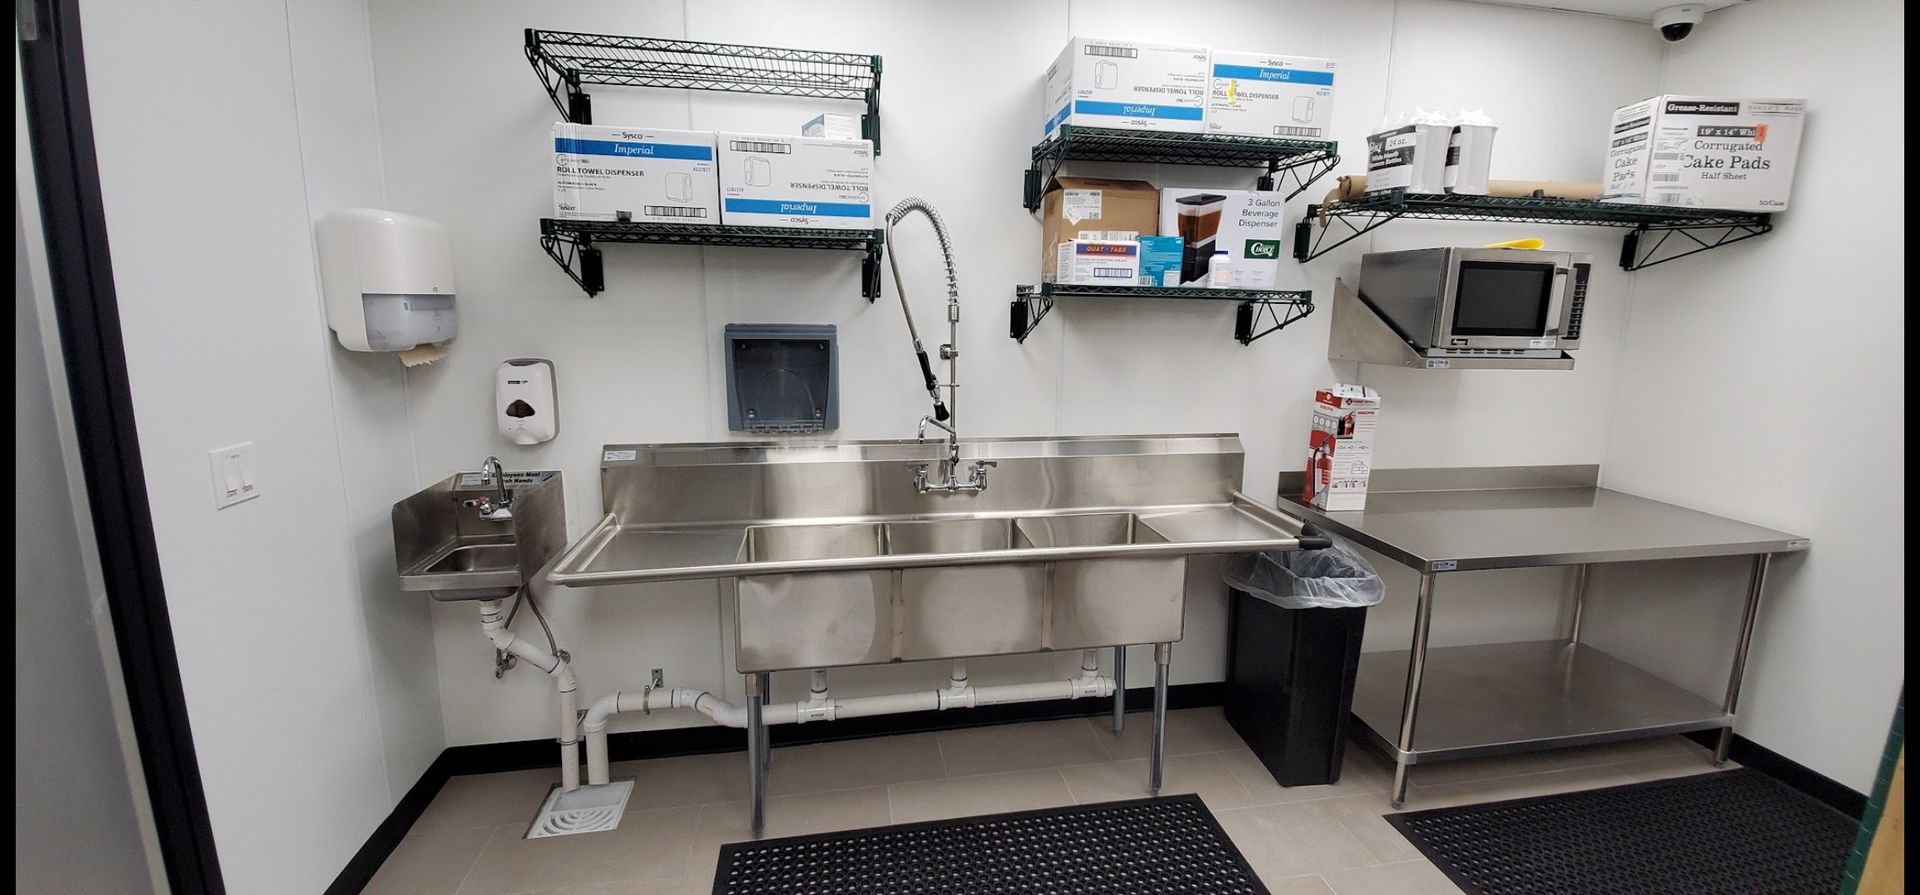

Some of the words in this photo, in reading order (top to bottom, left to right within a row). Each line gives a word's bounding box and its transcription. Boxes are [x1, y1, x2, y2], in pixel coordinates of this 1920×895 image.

[1268, 59, 1284, 67] Sysco
[1259, 69, 1290, 80] Imperial
[1122, 106, 1156, 116] Imperial
[1667, 104, 1737, 112] Grease-Resistant
[622, 132, 642, 140] Sysco
[614, 144, 654, 156] Imperial
[1610, 143, 1646, 158] Corrugated
[1694, 140, 1763, 152] Corrugated
[1615, 157, 1638, 168] Cake
[1730, 156, 1770, 170] Pads
[556, 166, 576, 174] ROLL
[606, 168, 645, 176] DISPENSER
[1701, 172, 1721, 180] Half
[1722, 172, 1747, 180] Sheet
[1248, 198, 1254, 206] 3
[1256, 198, 1280, 207] Gallon
[780, 203, 817, 214] Imperial
[1242, 208, 1279, 220] Beverage
[1238, 218, 1278, 228] Dispenser
